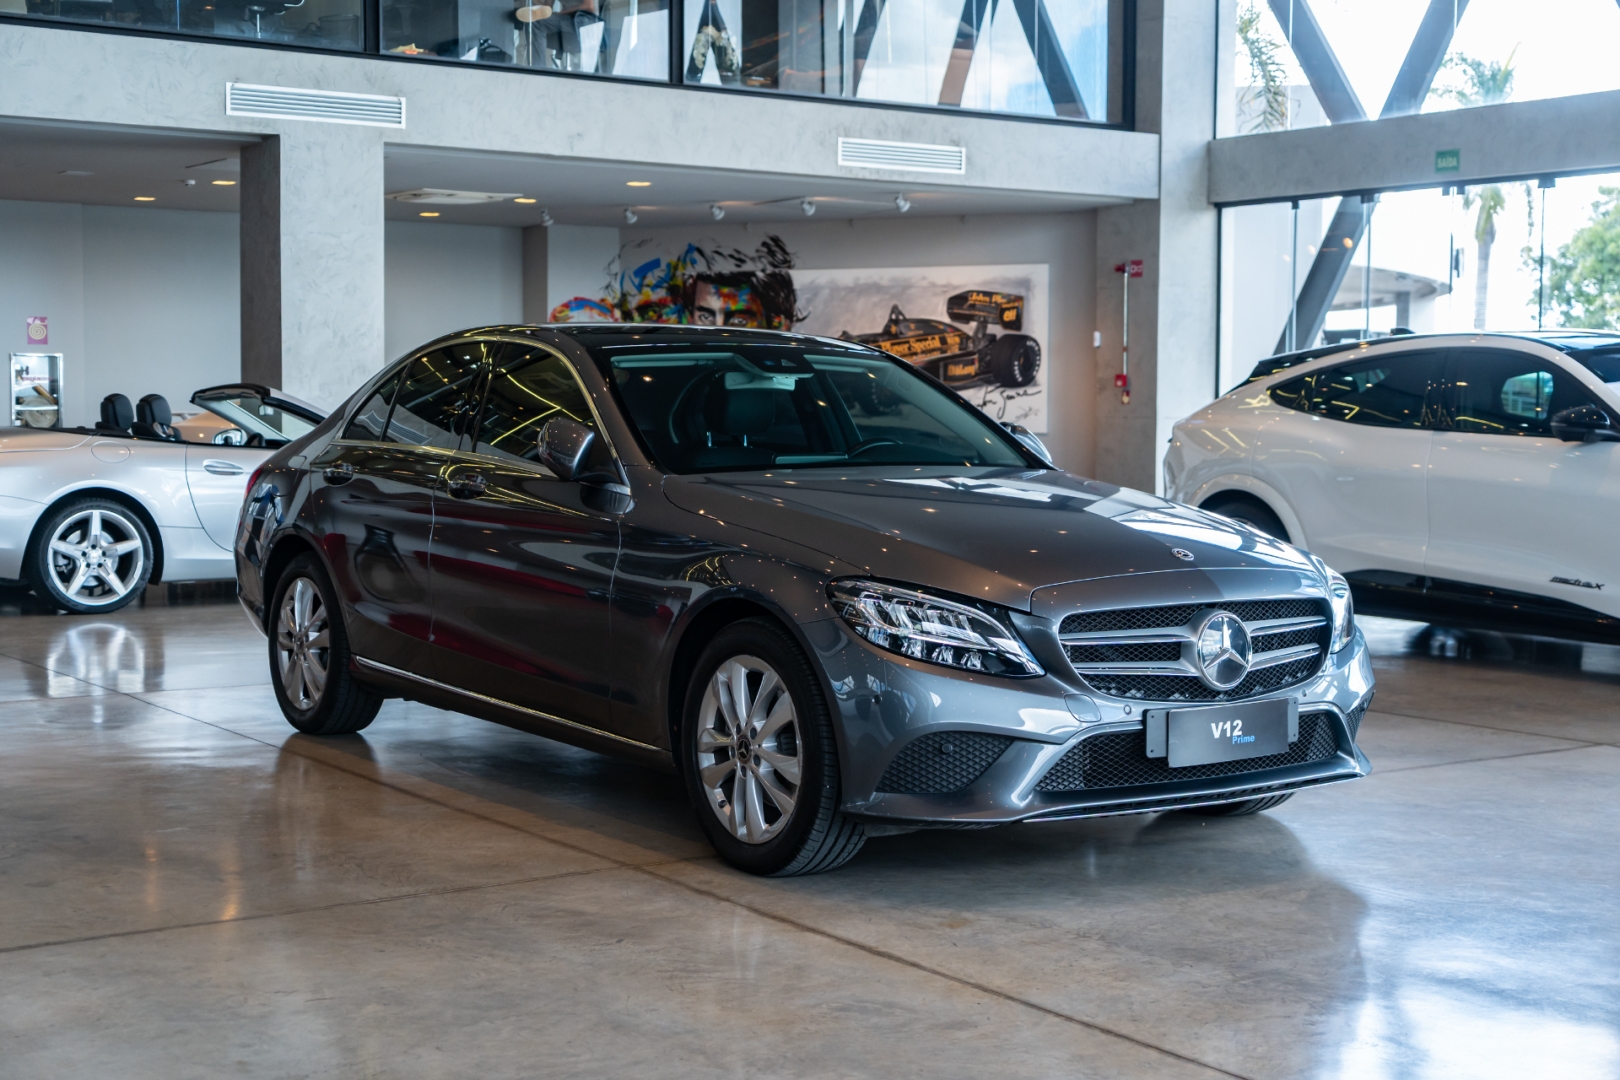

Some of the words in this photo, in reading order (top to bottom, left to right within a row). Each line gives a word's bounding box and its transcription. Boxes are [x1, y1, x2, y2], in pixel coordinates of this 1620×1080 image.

[1003, 308, 1017, 322] elf
[1211, 719, 1243, 739] V12
[1232, 734, 1256, 745] Prime
